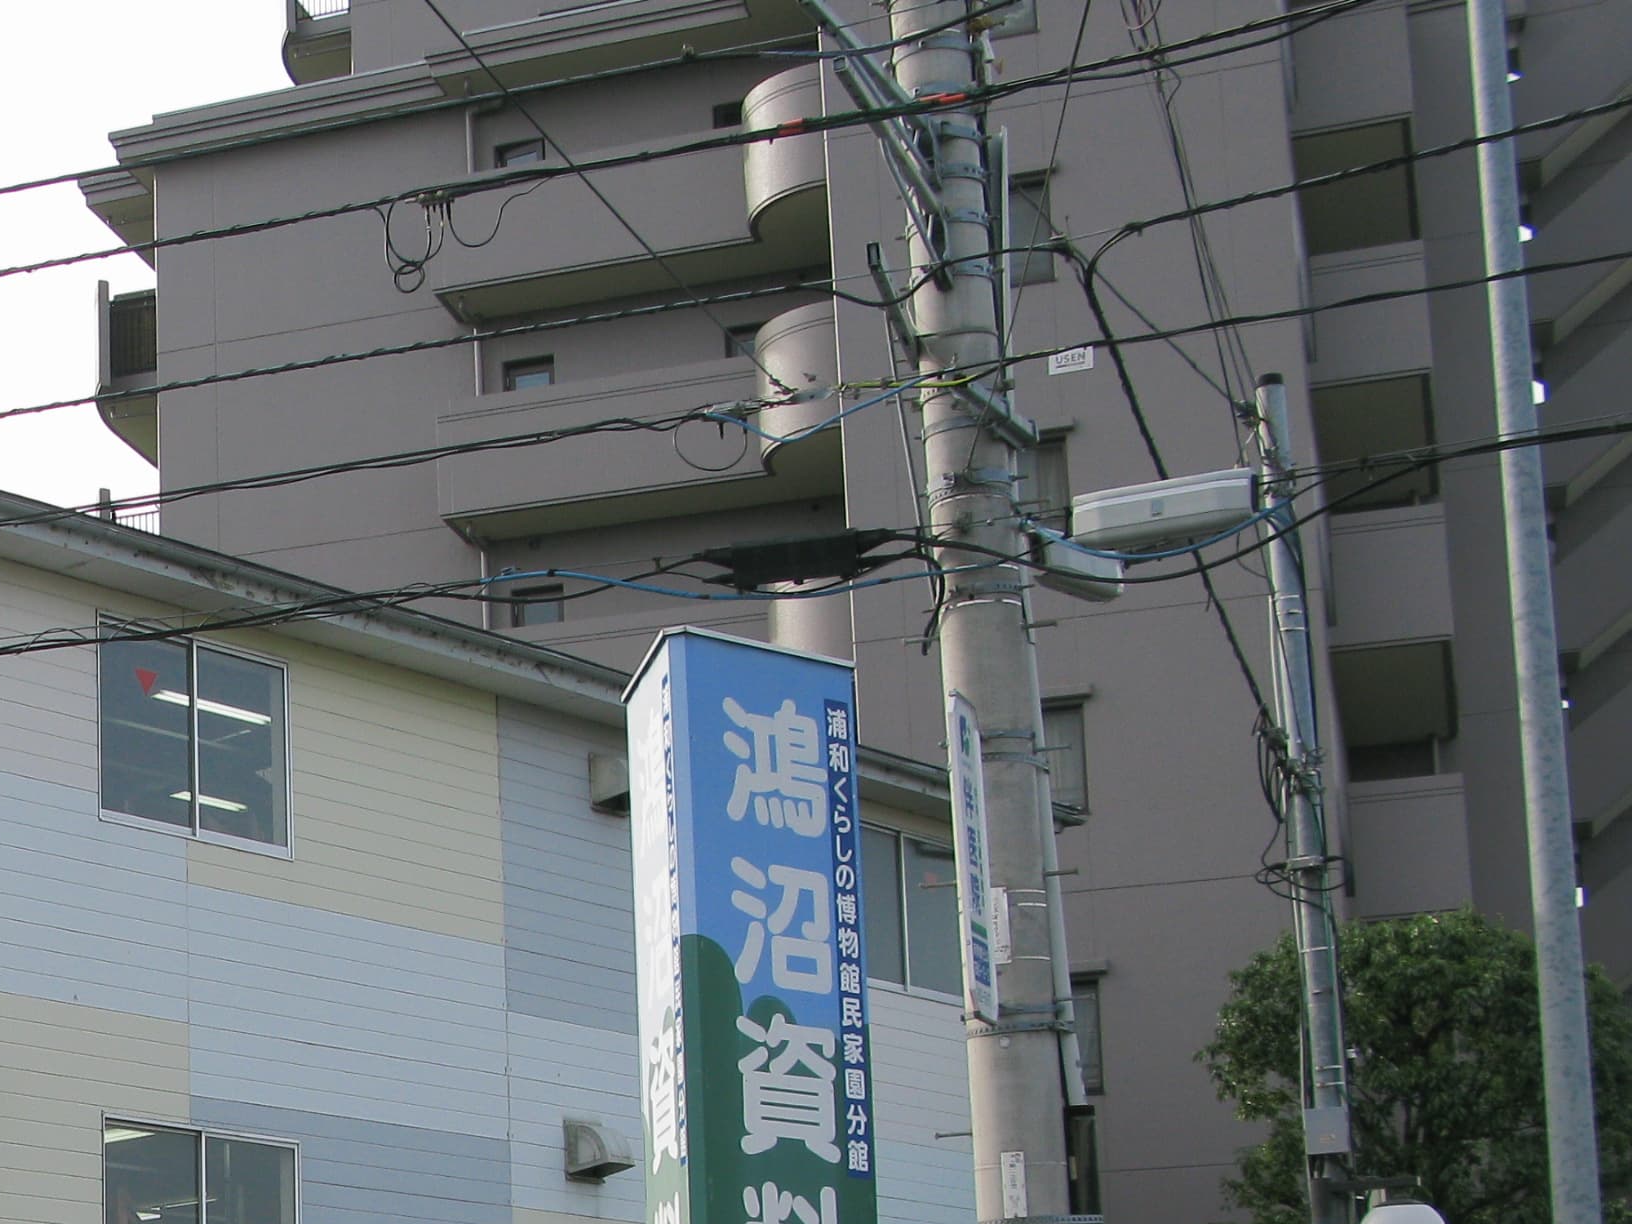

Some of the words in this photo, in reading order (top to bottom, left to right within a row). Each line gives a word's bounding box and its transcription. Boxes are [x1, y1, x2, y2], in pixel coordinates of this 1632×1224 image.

[1055, 352, 1086, 365] USEN
[827, 708, 869, 1173] 浦和くらしの博物館民家園分館
